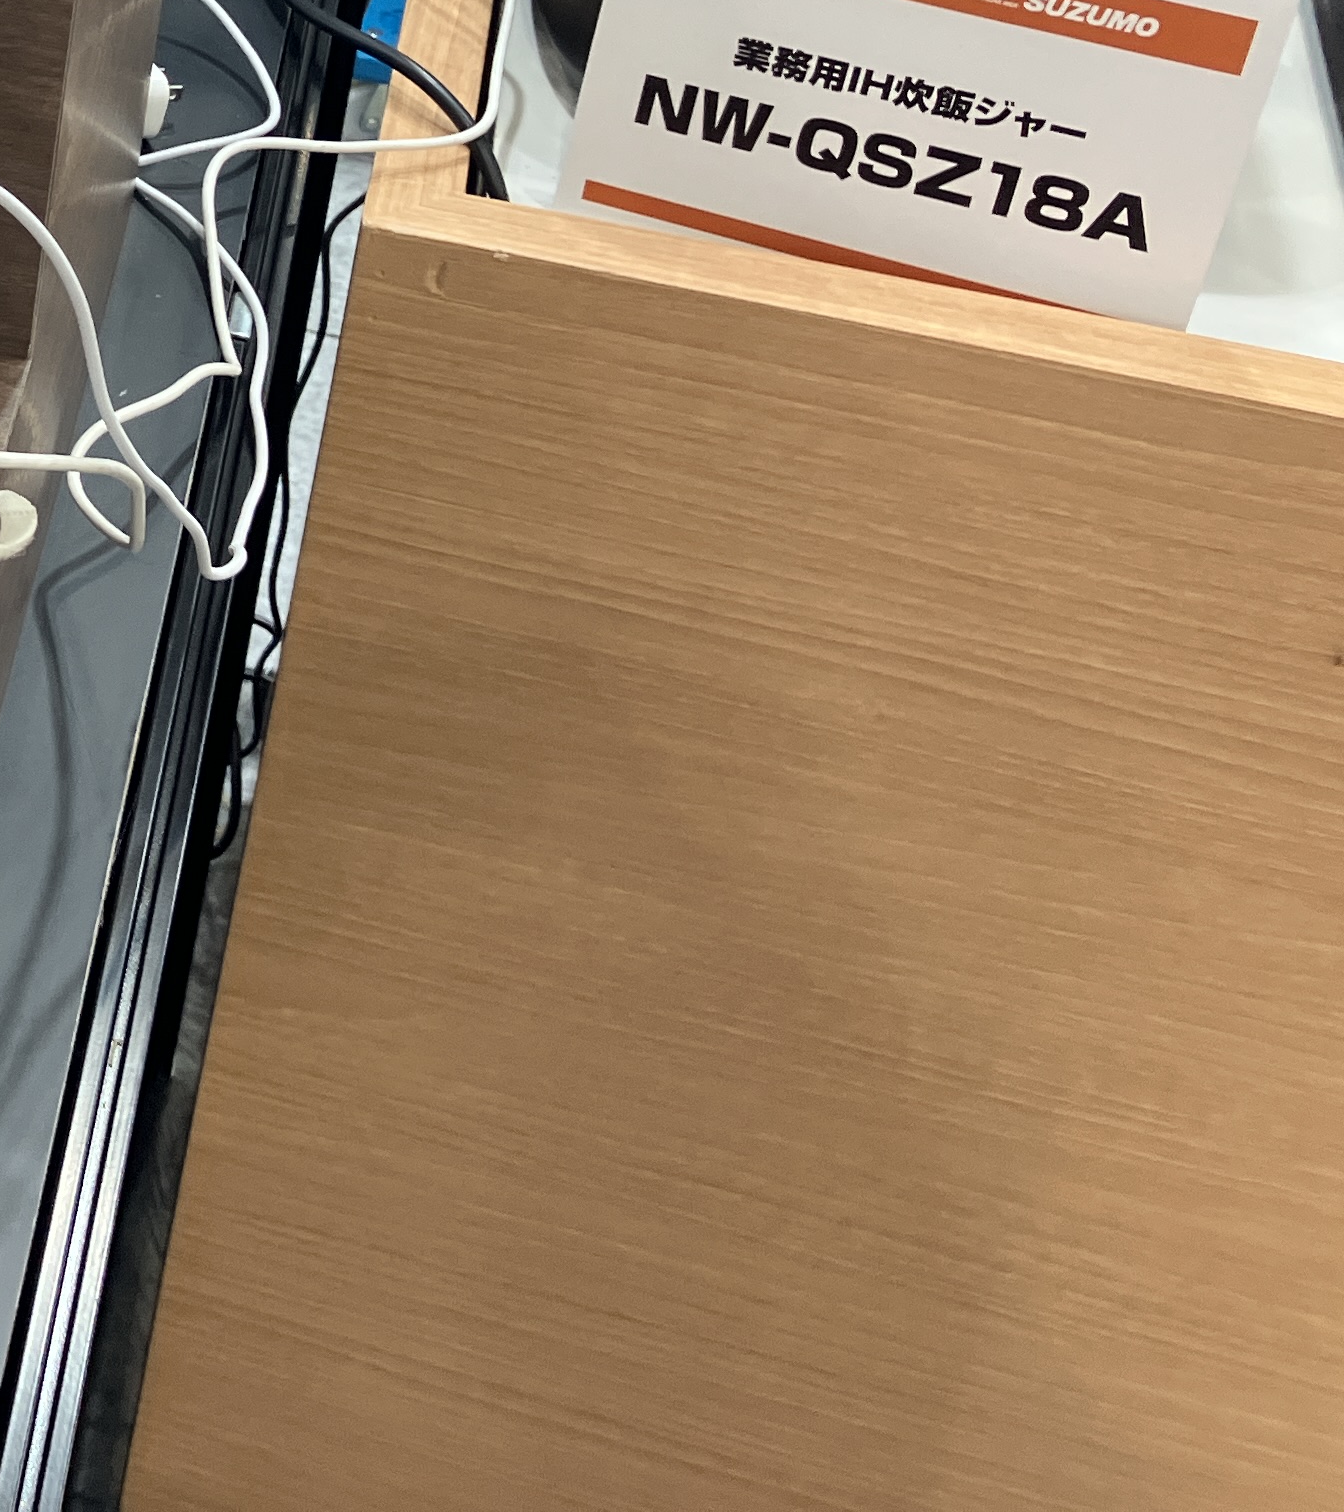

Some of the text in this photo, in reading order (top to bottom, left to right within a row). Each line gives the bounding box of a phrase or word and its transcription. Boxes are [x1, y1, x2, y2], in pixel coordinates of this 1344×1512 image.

[733, 37, 1088, 142] 業務用IH炊飯ジャー
[634, 74, 1148, 253] NW-QSZ18A
